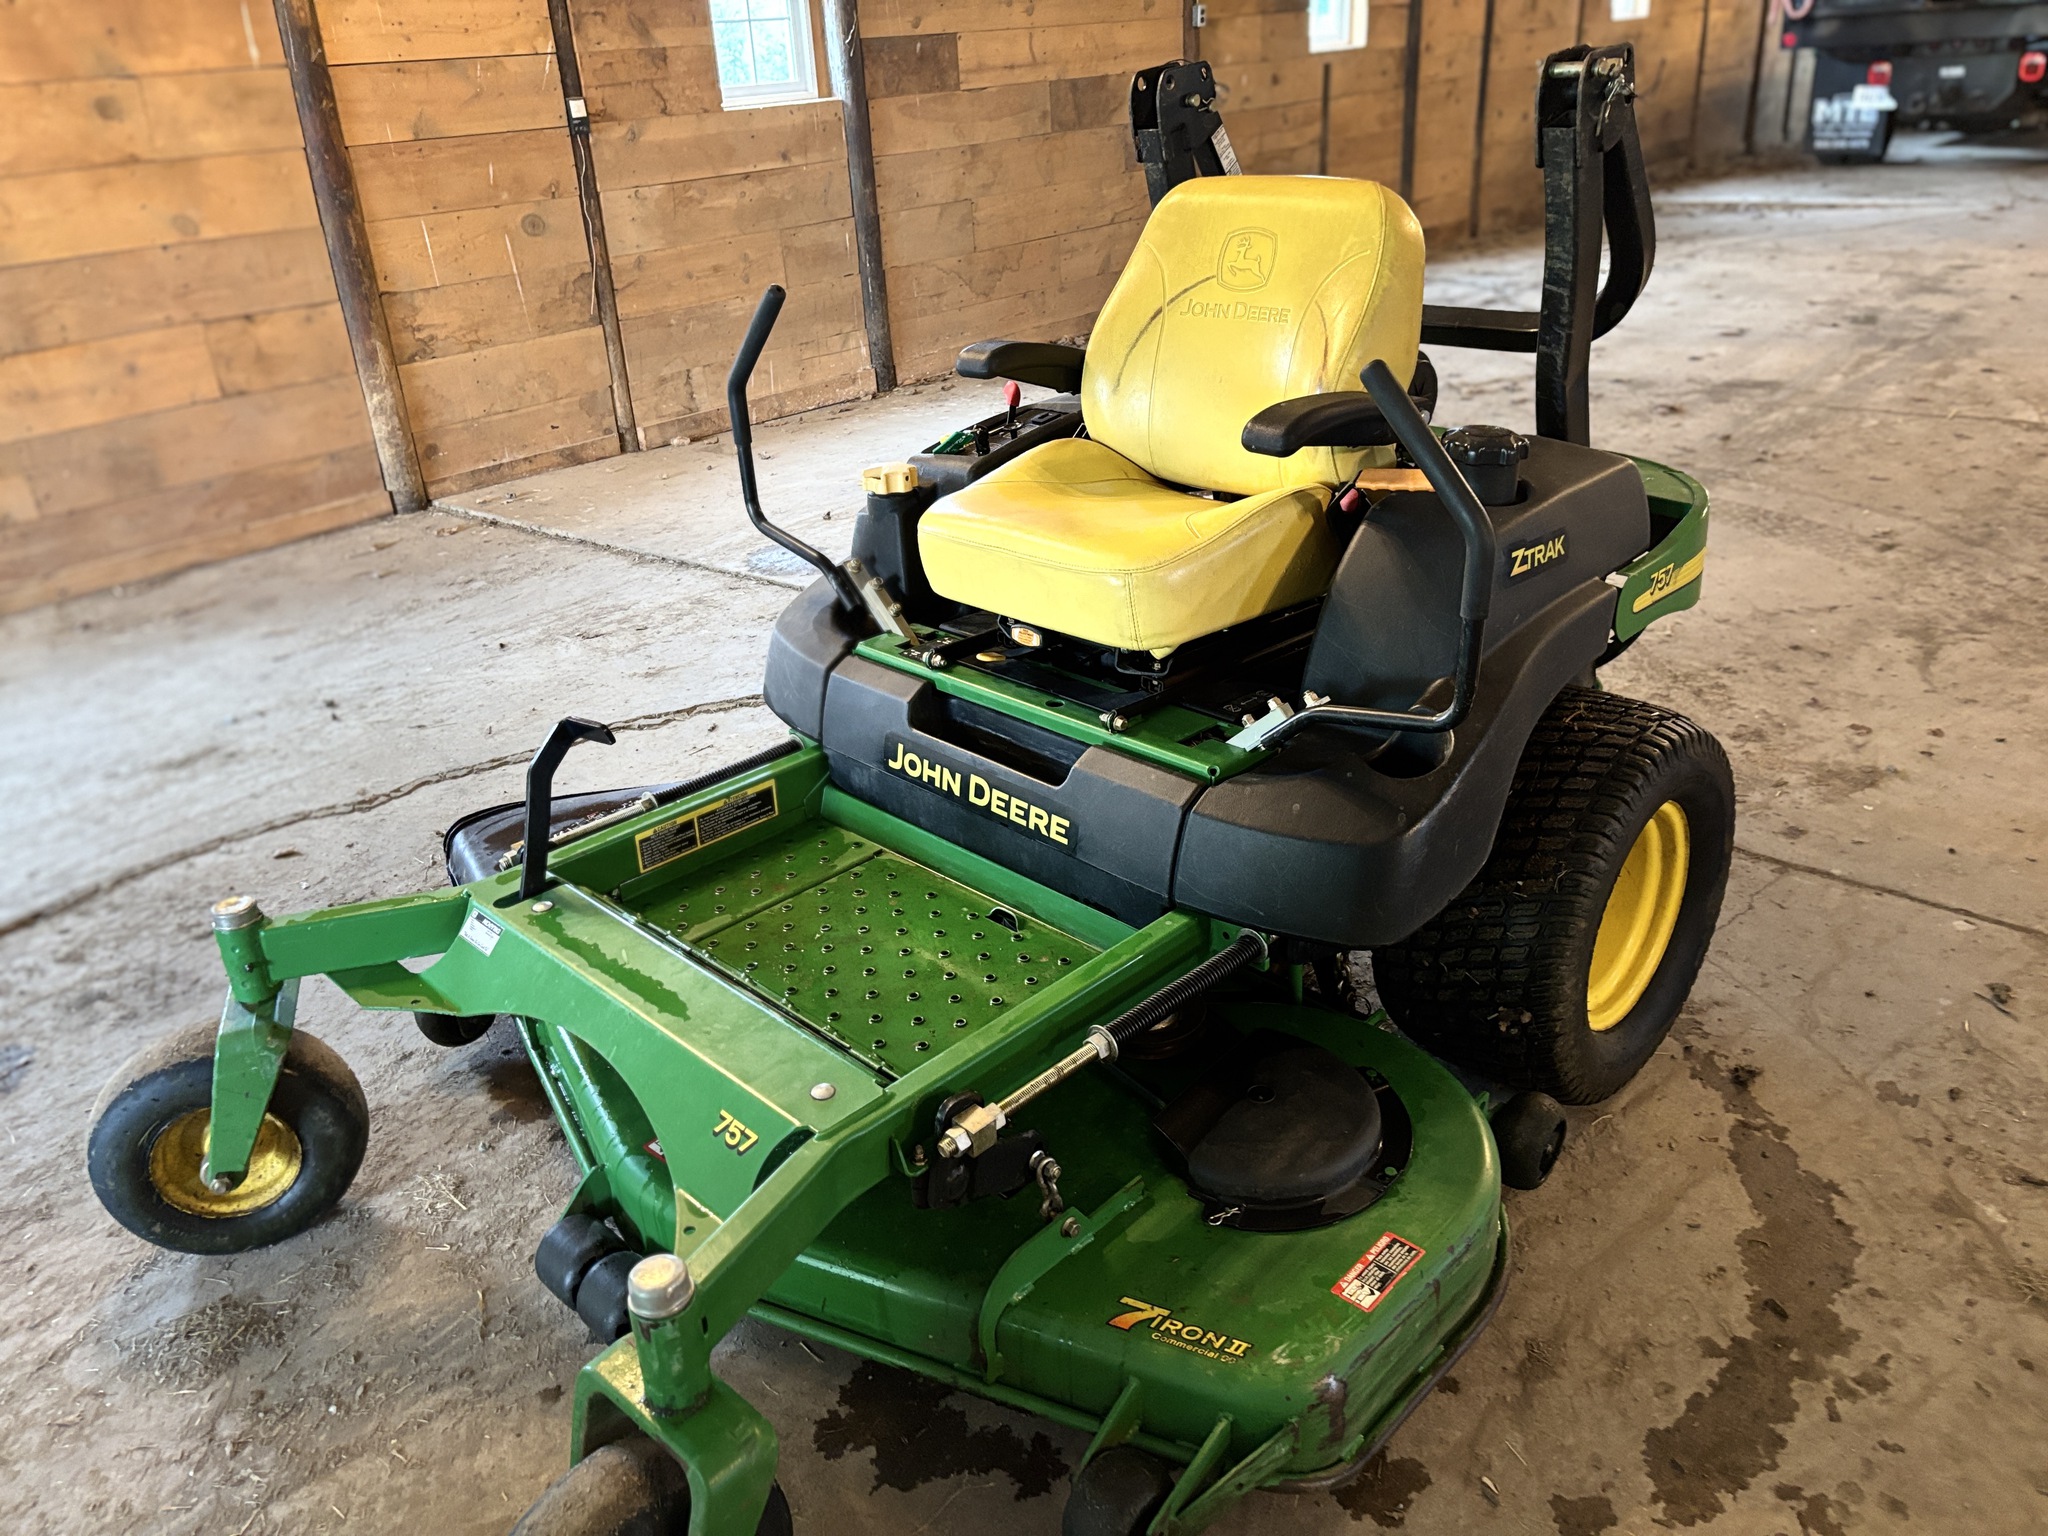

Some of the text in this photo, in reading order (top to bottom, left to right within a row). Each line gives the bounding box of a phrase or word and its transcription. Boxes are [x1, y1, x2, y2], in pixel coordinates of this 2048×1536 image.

[1179, 298, 1291, 324] JOHN DEERE
[1510, 534, 1566, 577] ZTRAK
[1650, 562, 1675, 596] 757
[888, 742, 1070, 846] JOHN DEERE
[712, 1108, 759, 1156] 757
[1369, 1235, 1392, 1255] PELIGRO
[1343, 1263, 1366, 1283] DANGER
[1151, 1332, 1220, 1361] Commercial
